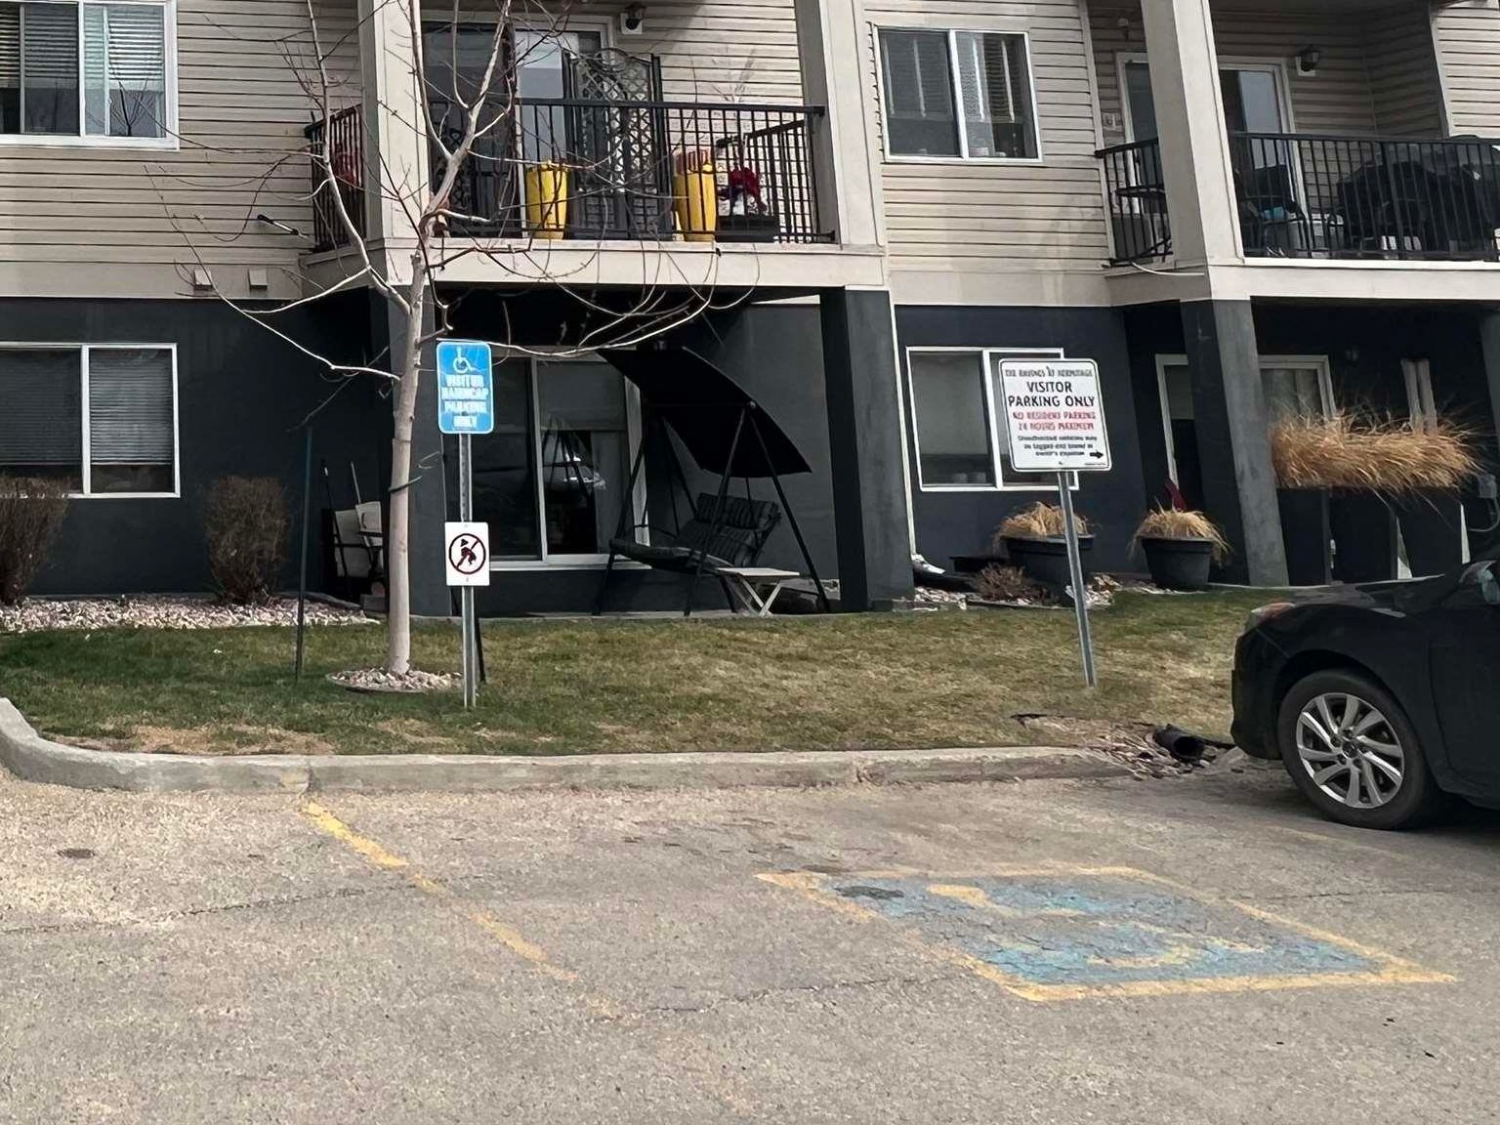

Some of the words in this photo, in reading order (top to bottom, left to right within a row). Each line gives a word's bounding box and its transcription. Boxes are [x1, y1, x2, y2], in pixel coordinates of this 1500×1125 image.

[1026, 381, 1073, 393] VISITOR
[1008, 395, 1060, 407] PARKING
[1064, 395, 1095, 407] ONLY
